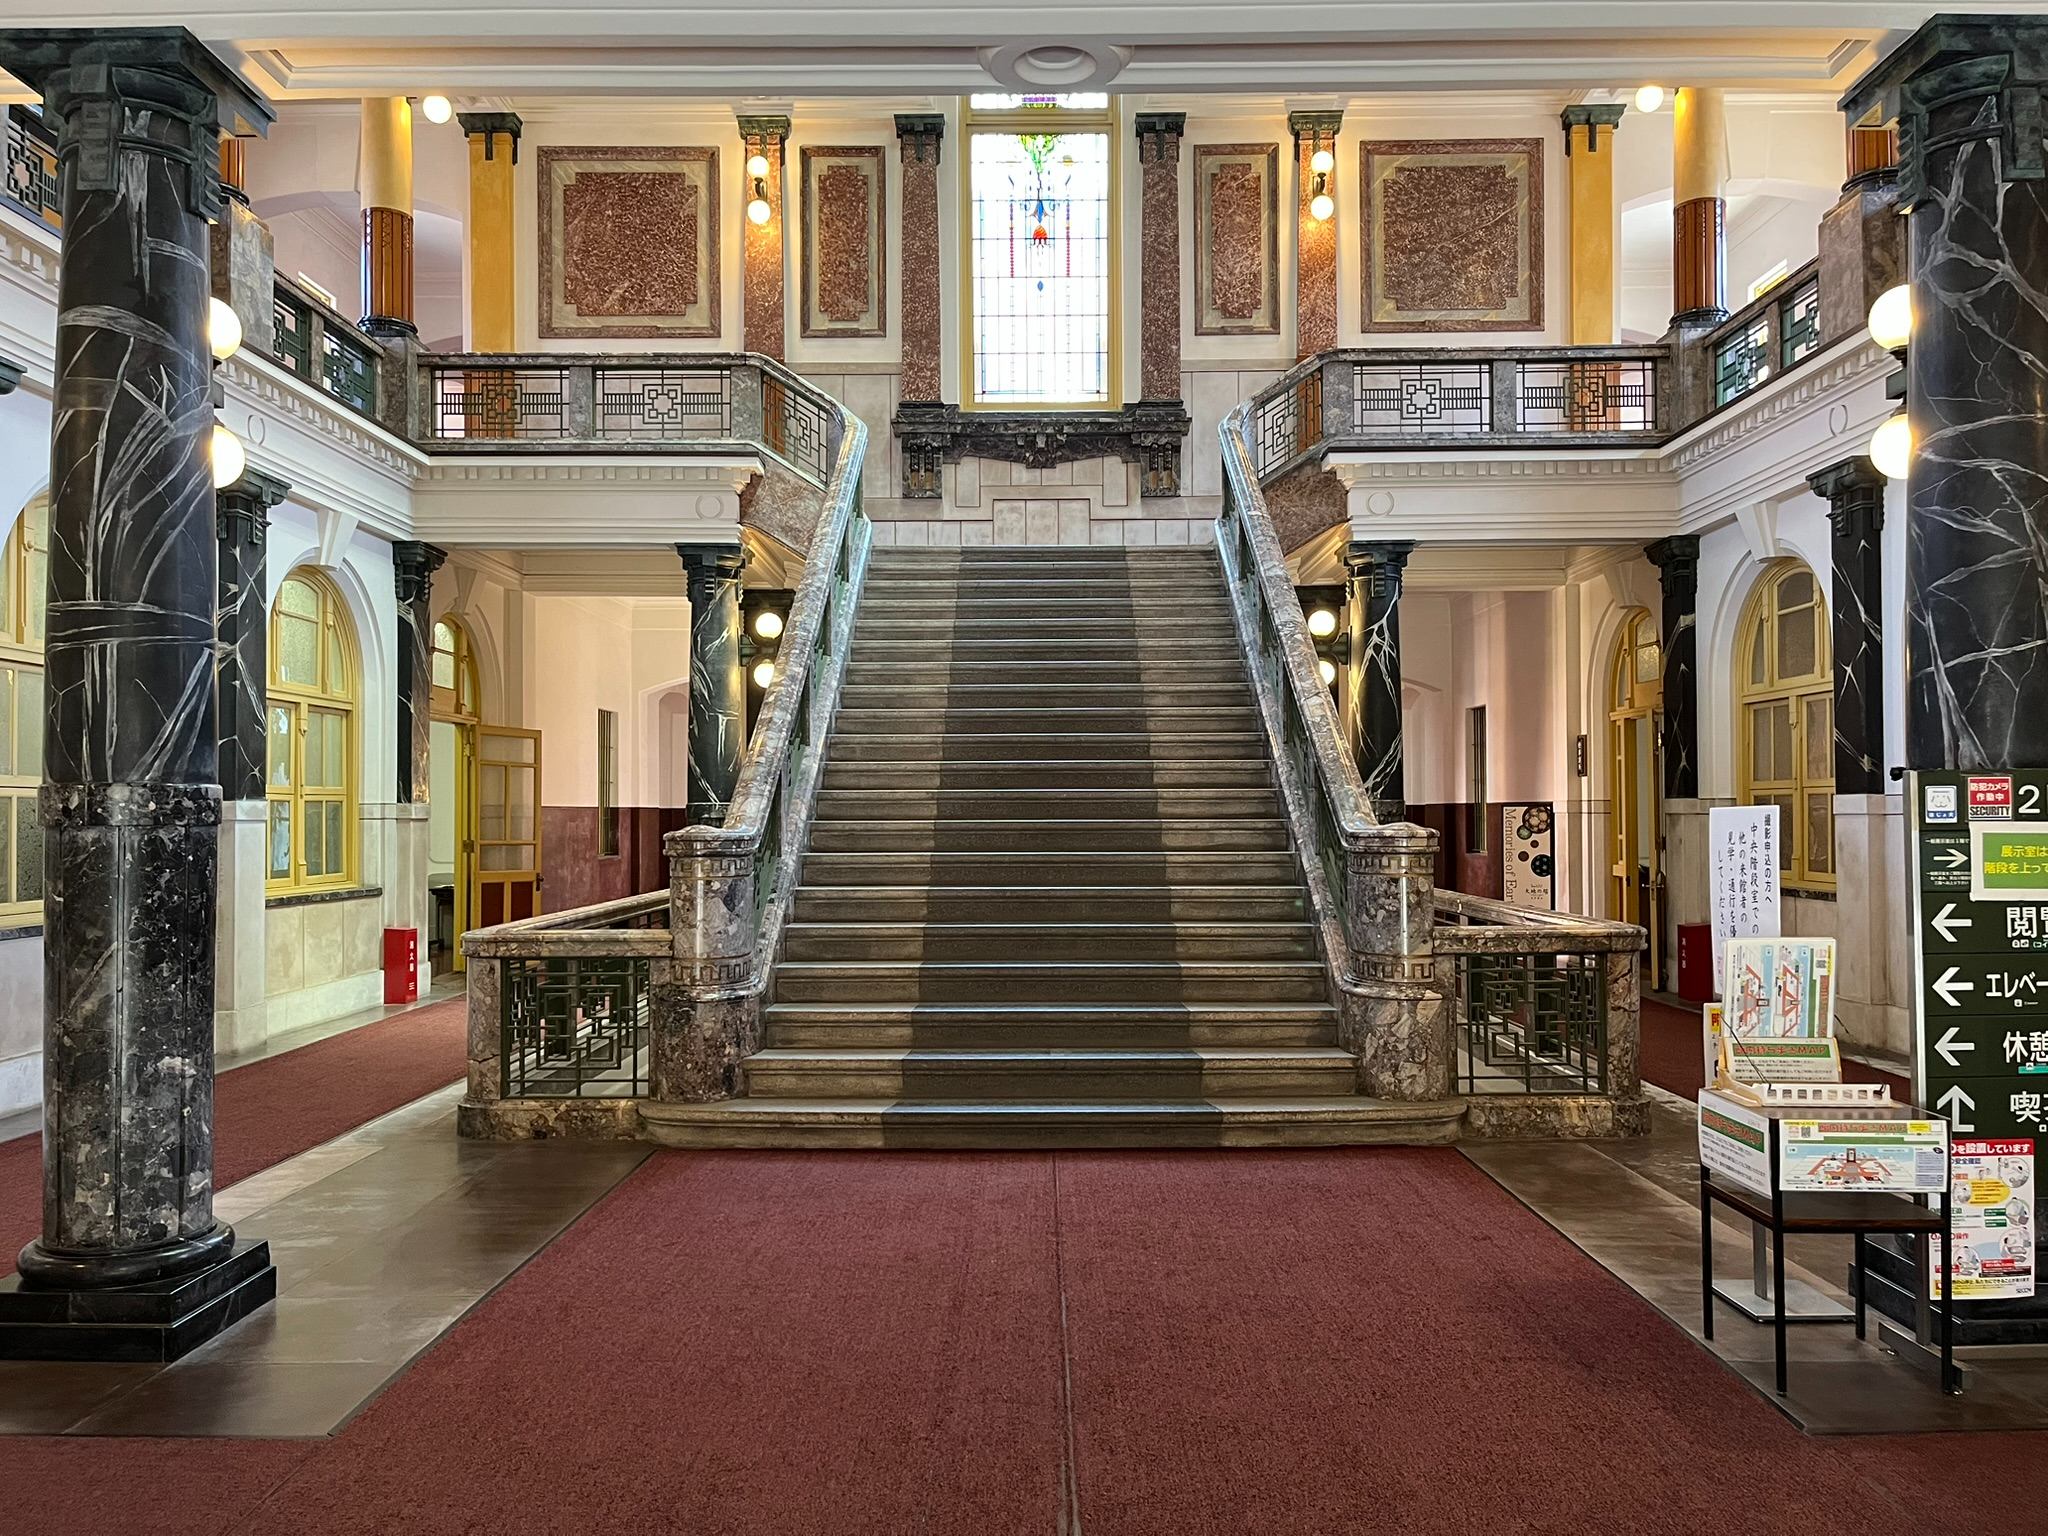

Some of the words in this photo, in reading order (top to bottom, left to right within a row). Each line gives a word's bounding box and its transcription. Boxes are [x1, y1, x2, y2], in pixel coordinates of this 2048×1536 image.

[1970, 782, 2009, 791] 防犯カメラ
[1976, 793, 2005, 801] 作動中
[2018, 784, 2048, 814] 2
[1970, 806, 2010, 816] SECURITY
[1505, 808, 1517, 864] Memories
[2001, 845, 2048, 858] 展示室は
[1505, 864, 1516, 879] of
[1738, 832, 1748, 923] 他の来館者の
[1750, 822, 1759, 934] 中央階段室での
[1505, 879, 1518, 903] Ear
[2006, 906, 2048, 939] 閲
[1985, 971, 2048, 998] エレベー
[2009, 1090, 2048, 1123] 喫
